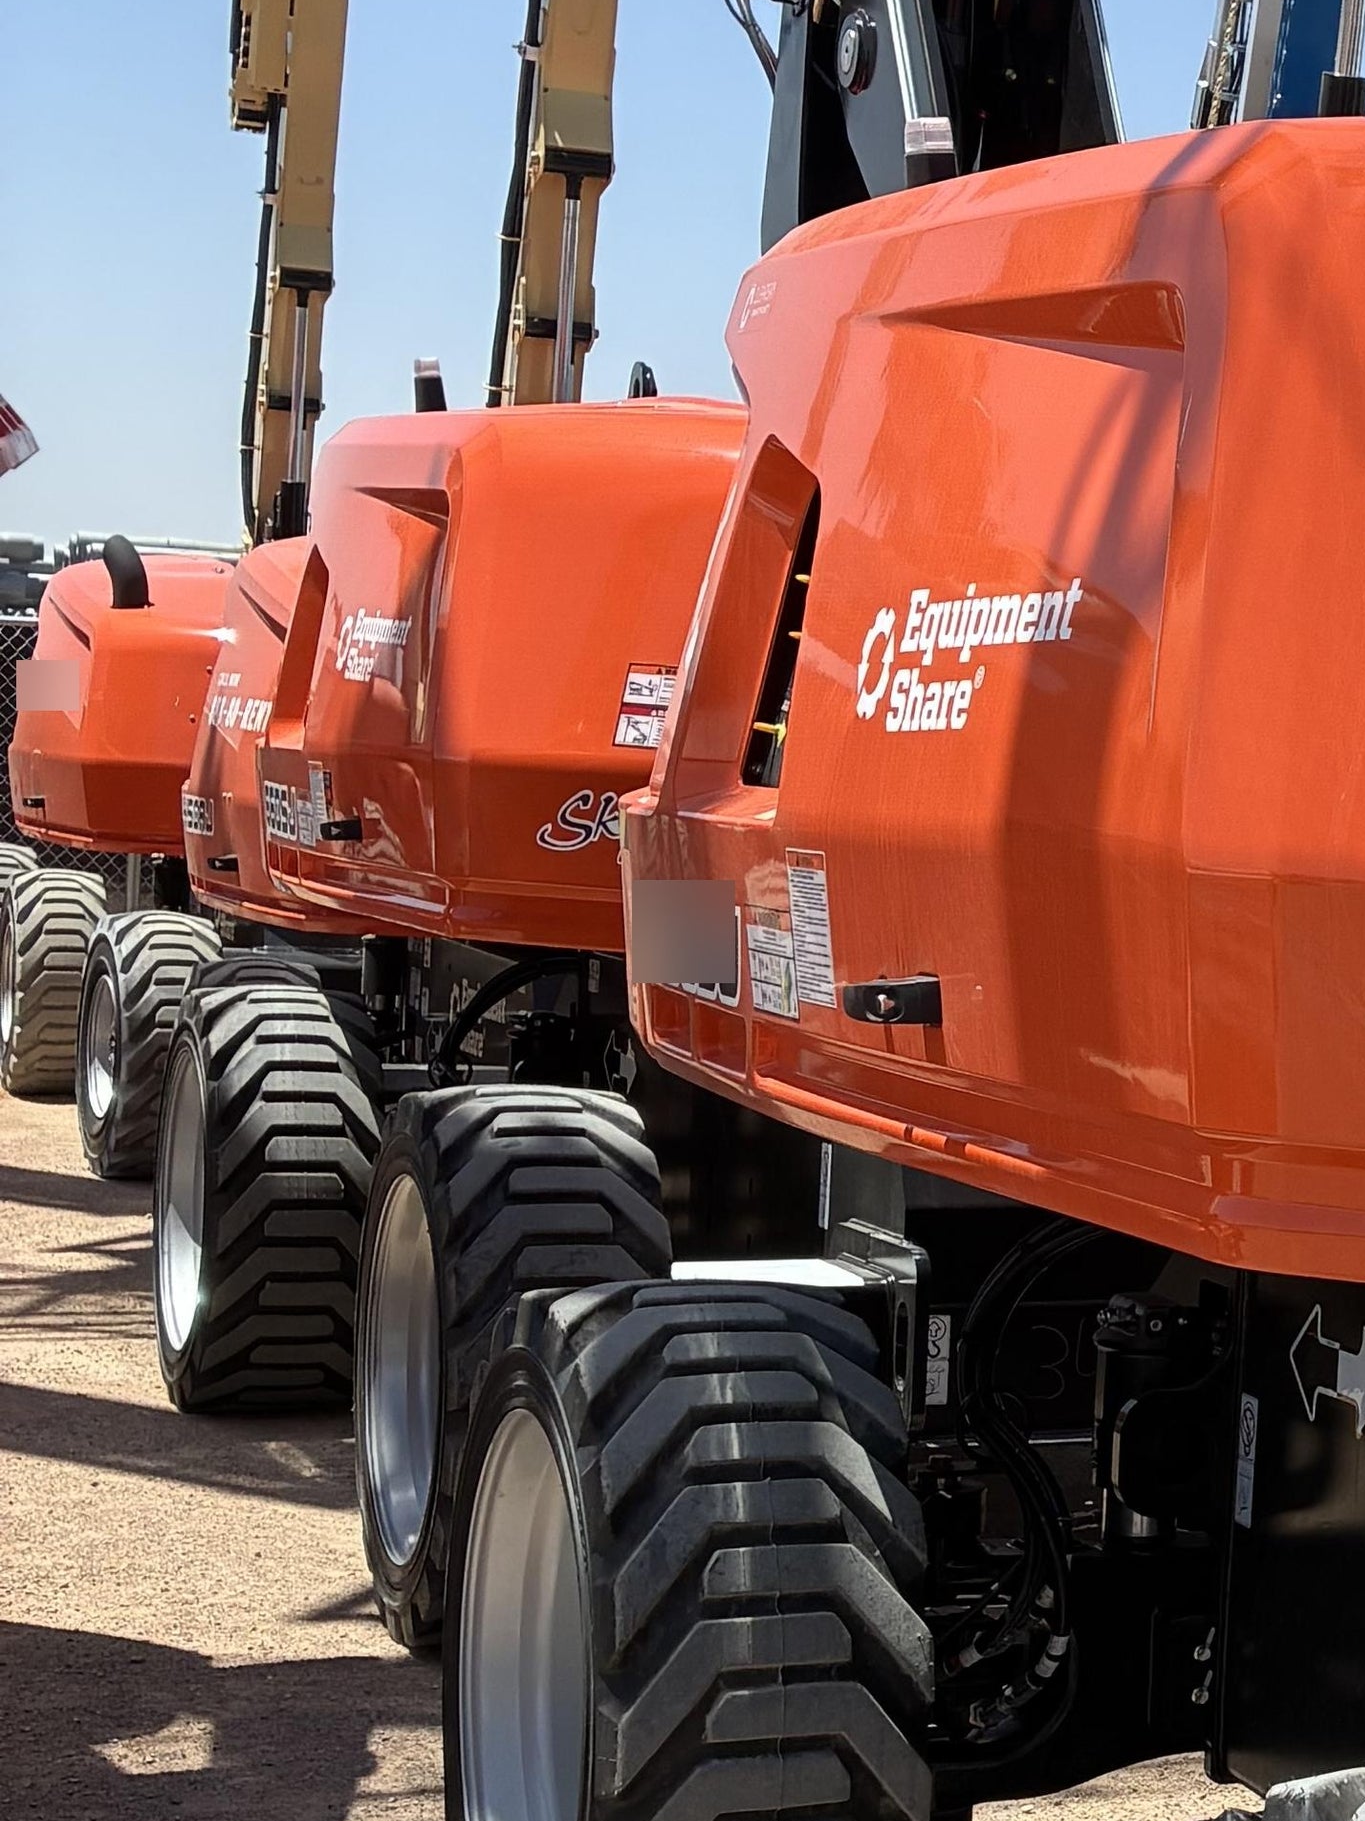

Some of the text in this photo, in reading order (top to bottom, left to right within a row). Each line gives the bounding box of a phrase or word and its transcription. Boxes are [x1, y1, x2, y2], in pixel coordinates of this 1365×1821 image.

[352, 608, 412, 650] Equipment
[899, 578, 1083, 667] Equipment
[344, 647, 375, 682] Share
[885, 667, 973, 732] Share
[538, 789, 627, 864] Sk
